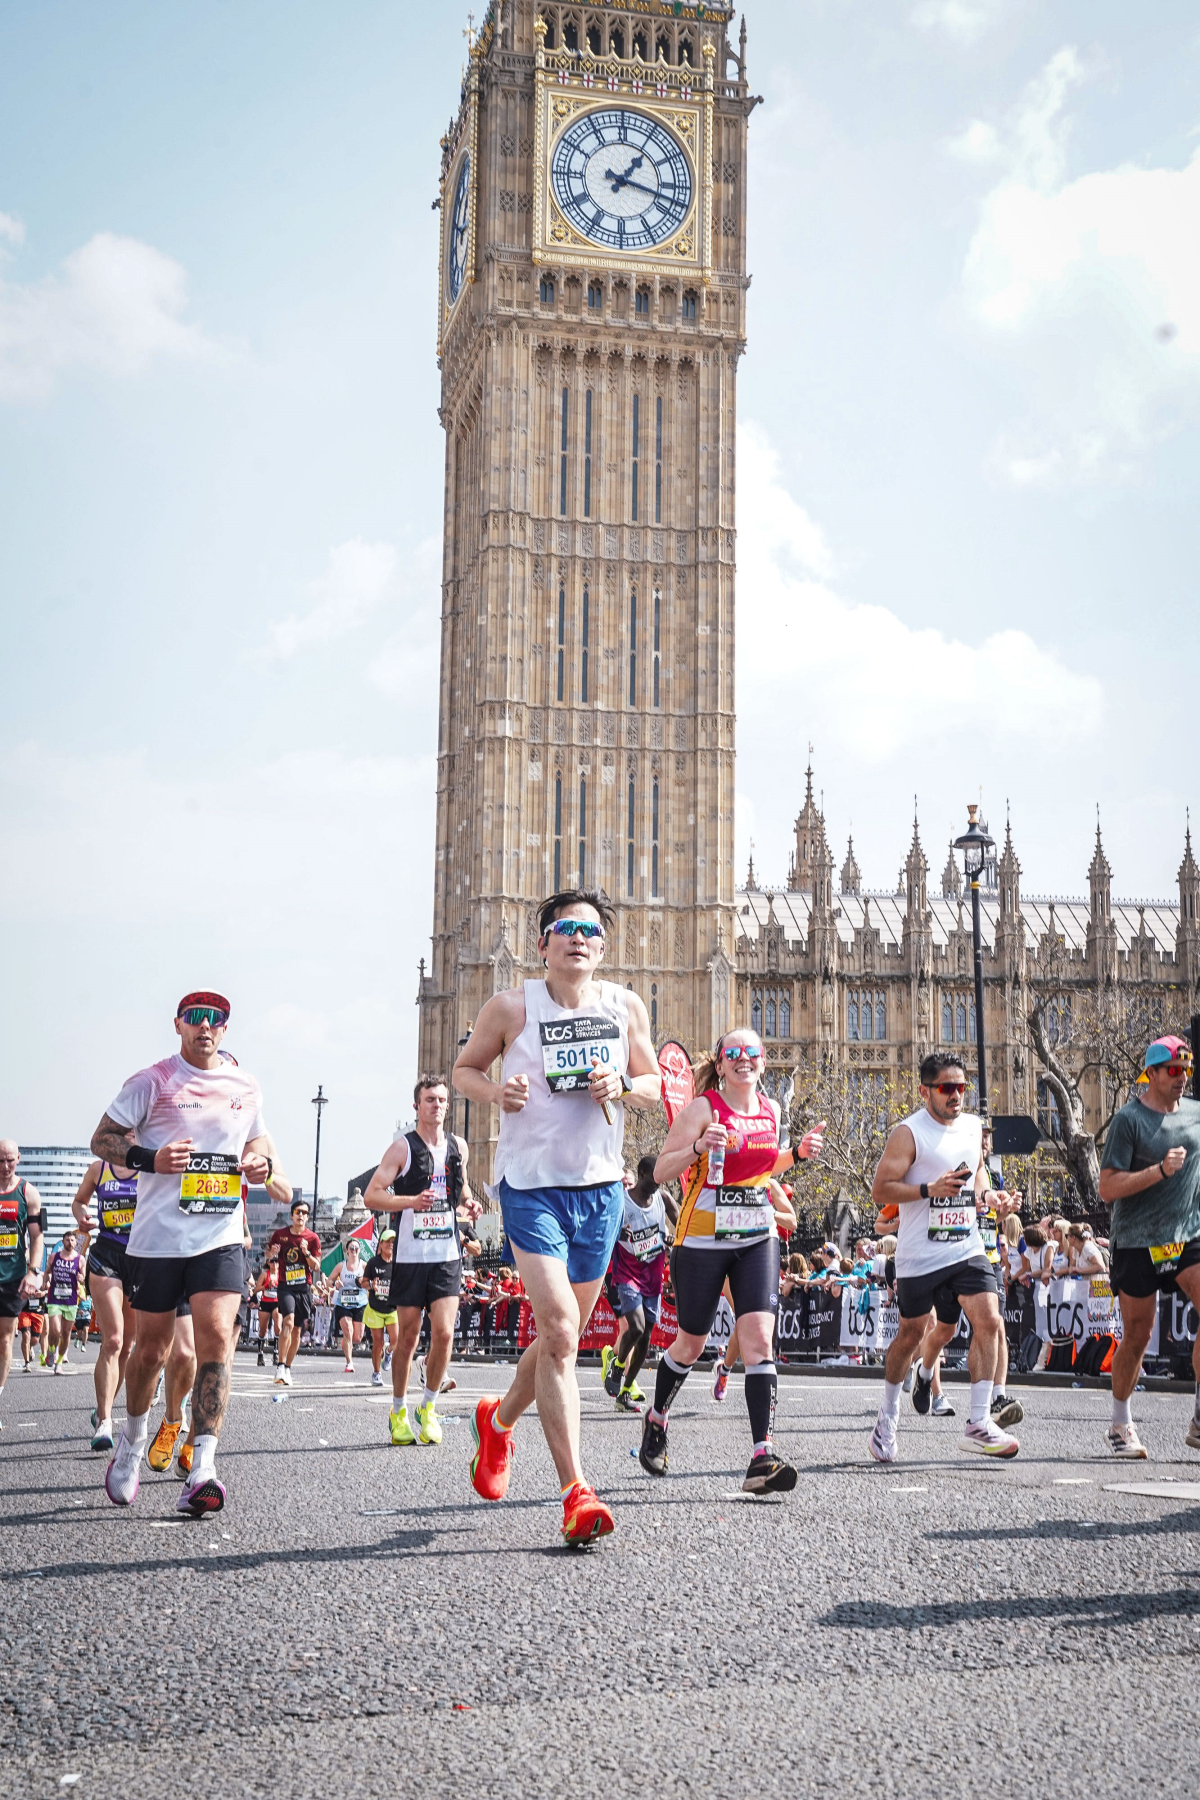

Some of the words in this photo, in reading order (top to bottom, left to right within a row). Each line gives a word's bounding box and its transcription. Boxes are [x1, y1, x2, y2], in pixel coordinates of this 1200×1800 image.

[545, 1025, 573, 1042] tcs
[575, 1023, 614, 1032] CONSULTANCY
[575, 1030, 601, 1039] SERVICES
[556, 1046, 610, 1068] 50150
[729, 1117, 773, 1131] VICKY
[196, 1179, 228, 1194] 2663
[720, 1188, 743, 1204] tcs
[422, 1216, 446, 1227] 9323
[725, 1211, 768, 1227] 41213
[55, 1259, 75, 1269] OLLY
[1046, 1293, 1084, 1341] tcs
[593, 1323, 614, 1334] Foundation
